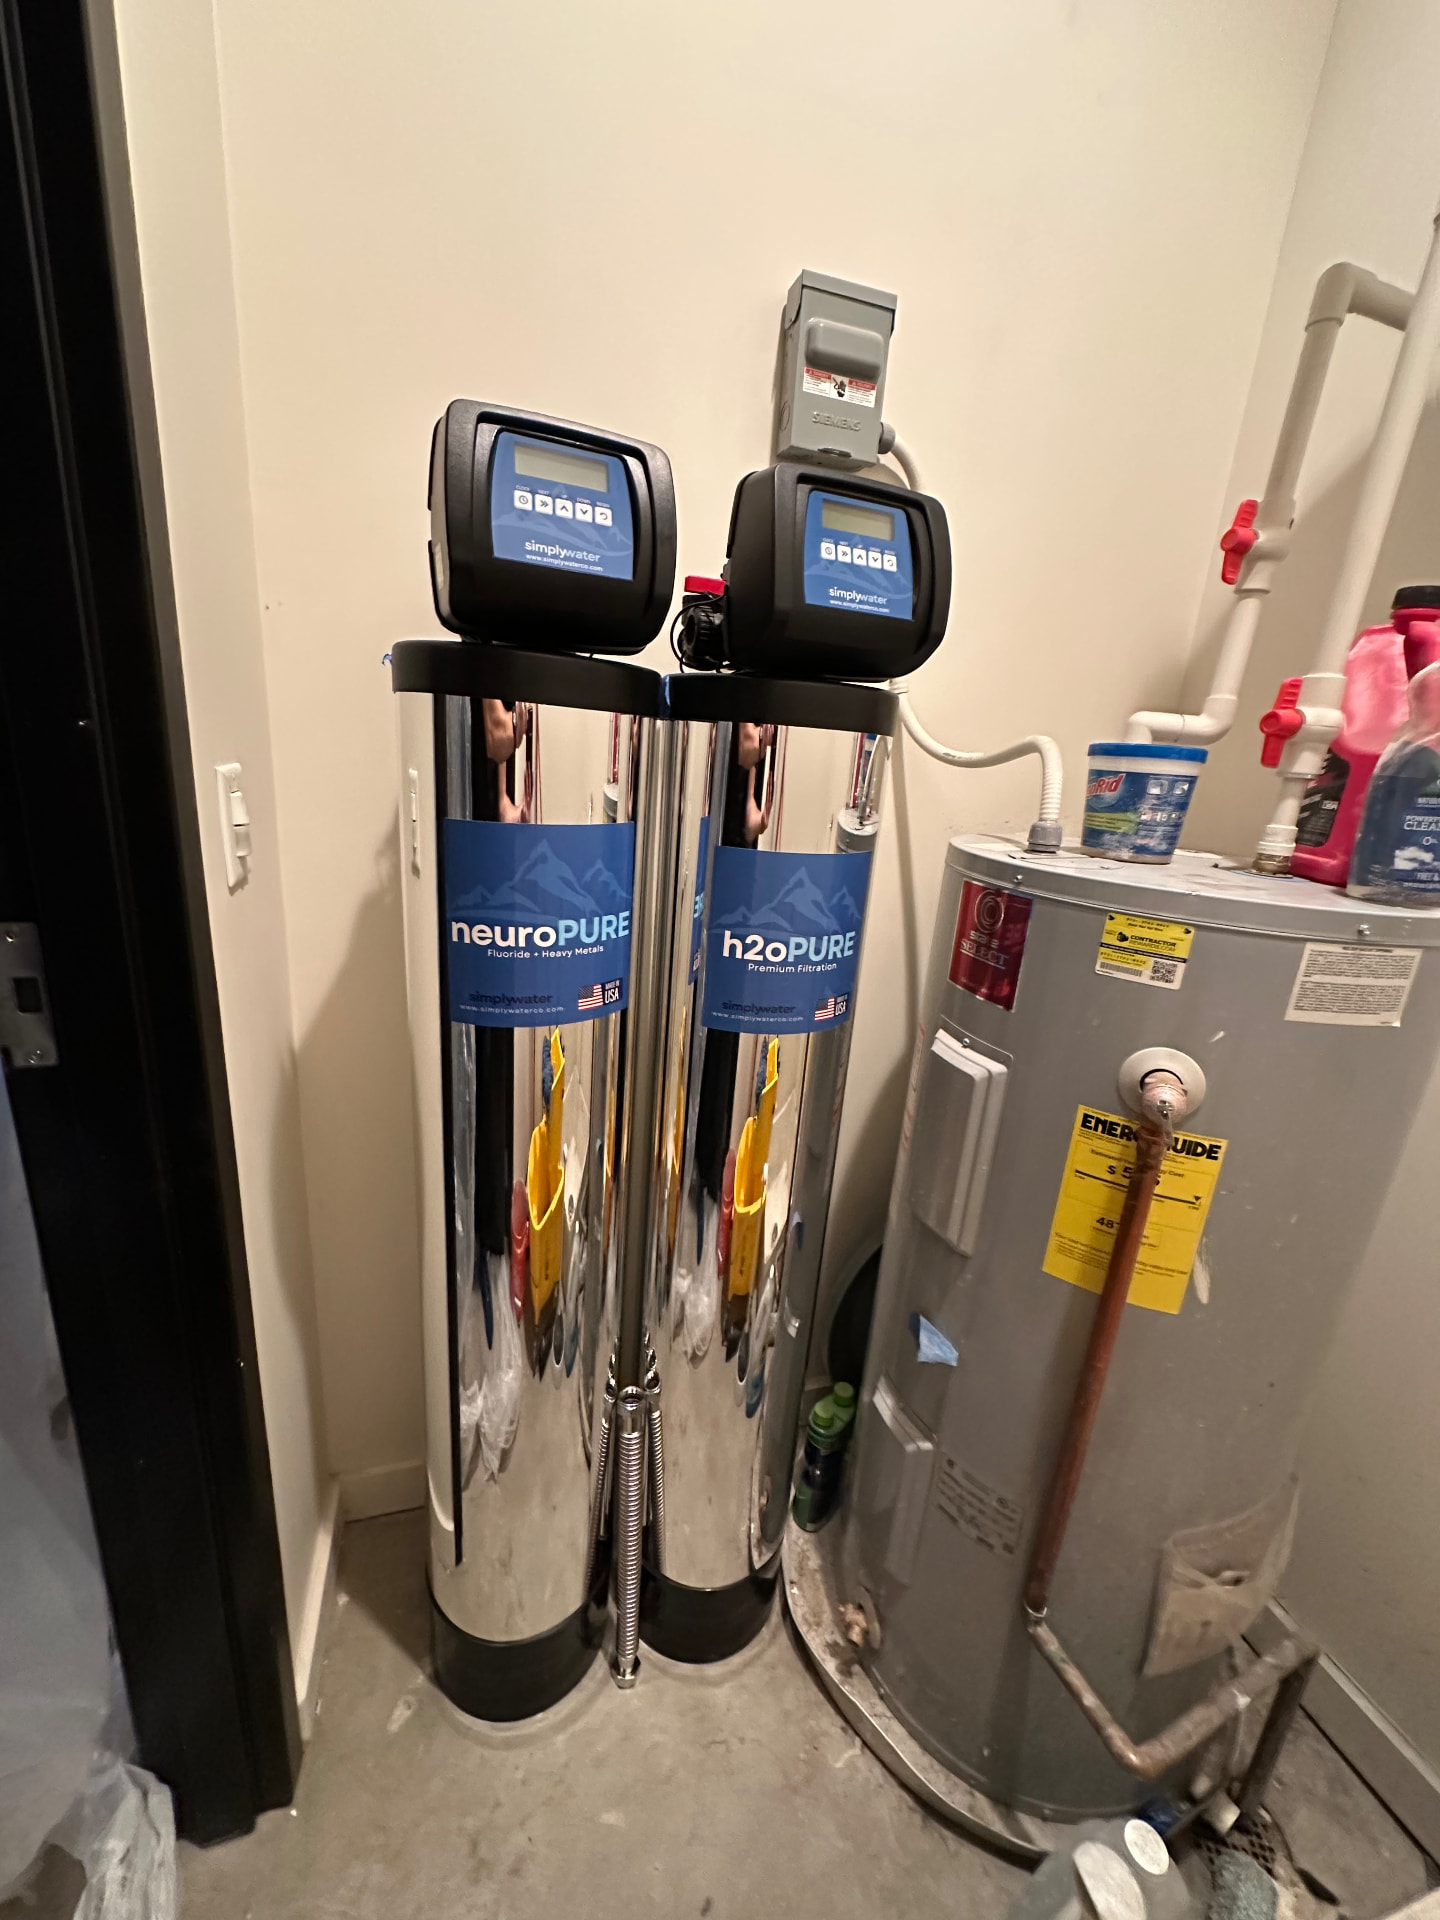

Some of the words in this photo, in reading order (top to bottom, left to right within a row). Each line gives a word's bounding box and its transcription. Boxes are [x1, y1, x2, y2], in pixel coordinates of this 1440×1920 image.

[812, 411, 861, 432] SIEMENS
[524, 539, 601, 563] simplywater
[828, 586, 888, 605] simplywater
[451, 910, 630, 948] neuroPURE
[722, 929, 856, 963] h2oPURE
[1130, 934, 1177, 948] CONTRACTOR
[487, 949, 531, 959] Fluoride
[542, 949, 573, 960] Heavy
[575, 945, 604, 956] Metals
[961, 938, 1010, 966] SELECT
[748, 962, 795, 973] Premium
[797, 962, 837, 973] Filtration
[468, 991, 553, 1006] simplywater
[604, 987, 620, 1004] USA
[721, 1000, 796, 1014] simplywater
[835, 1001, 846, 1016] USA
